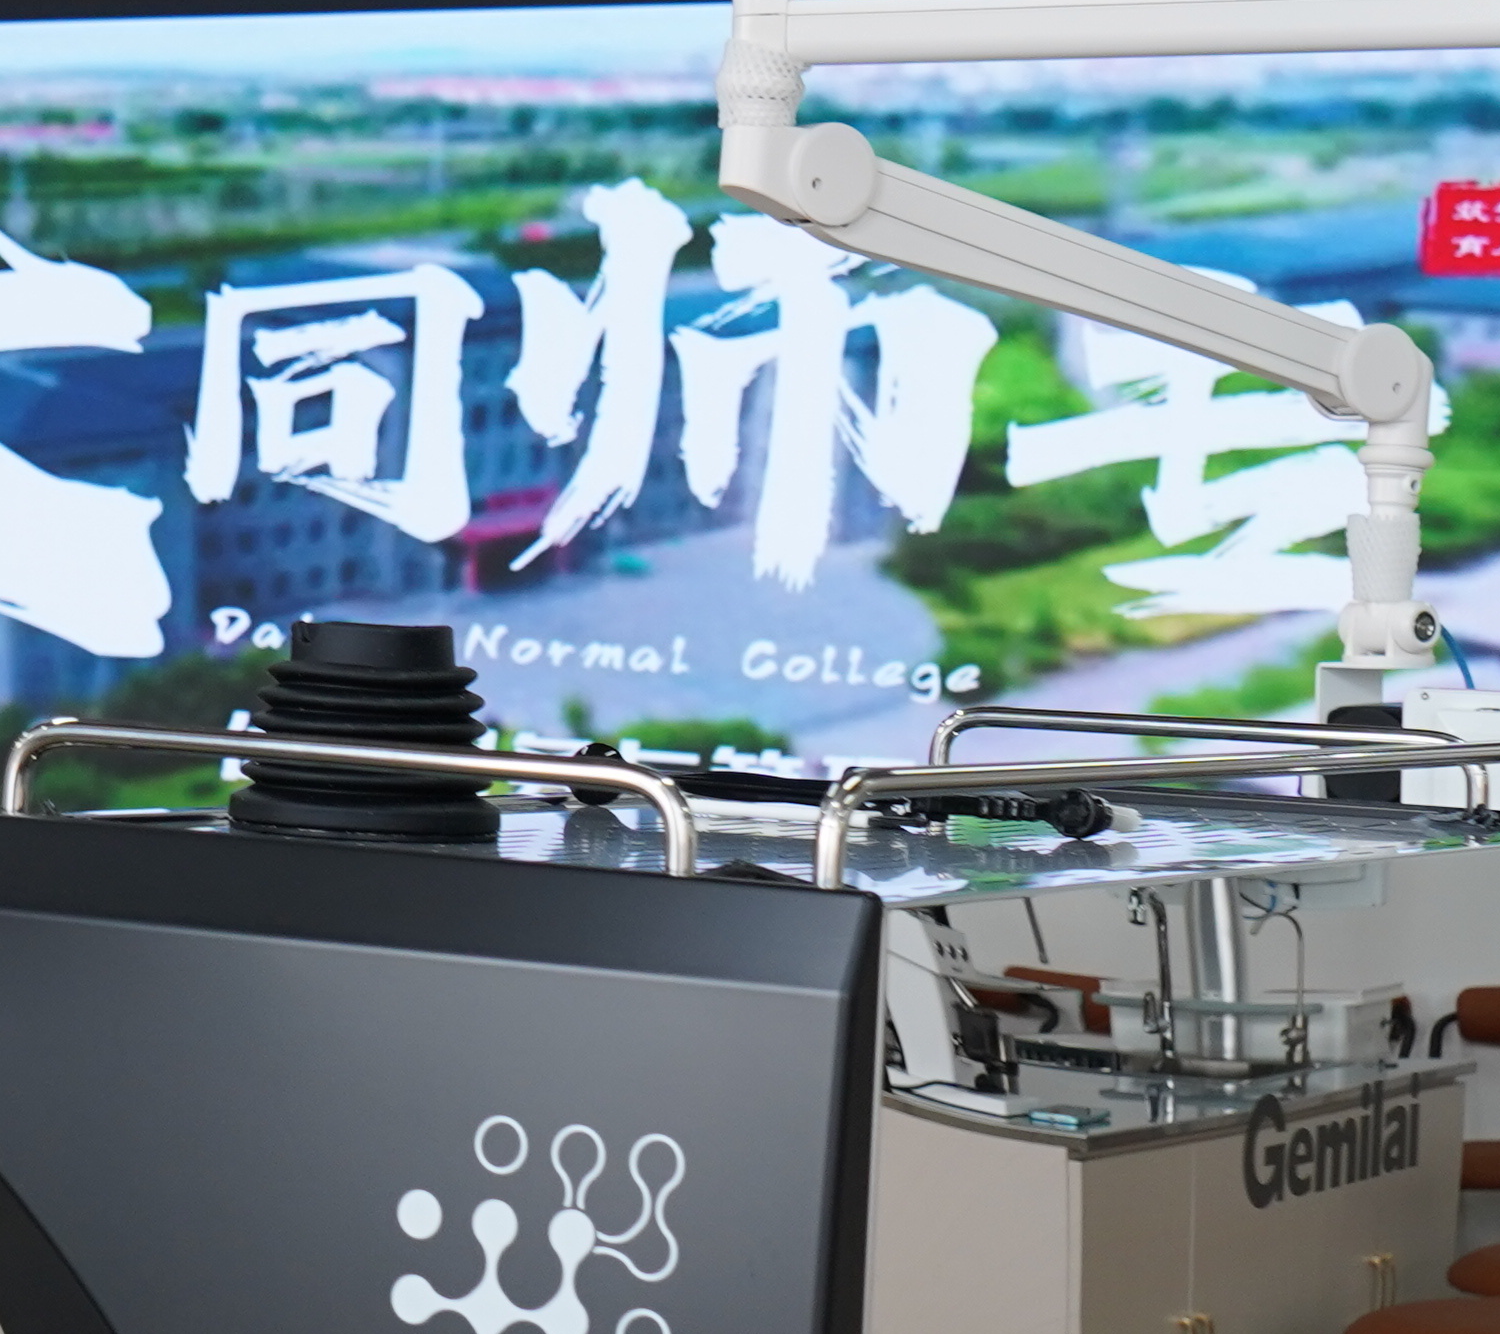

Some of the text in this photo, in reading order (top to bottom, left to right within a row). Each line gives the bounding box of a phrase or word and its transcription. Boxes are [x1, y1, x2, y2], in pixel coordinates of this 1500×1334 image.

[463, 622, 982, 705] Normal College
[1243, 1072, 1421, 1209] Gemilai
